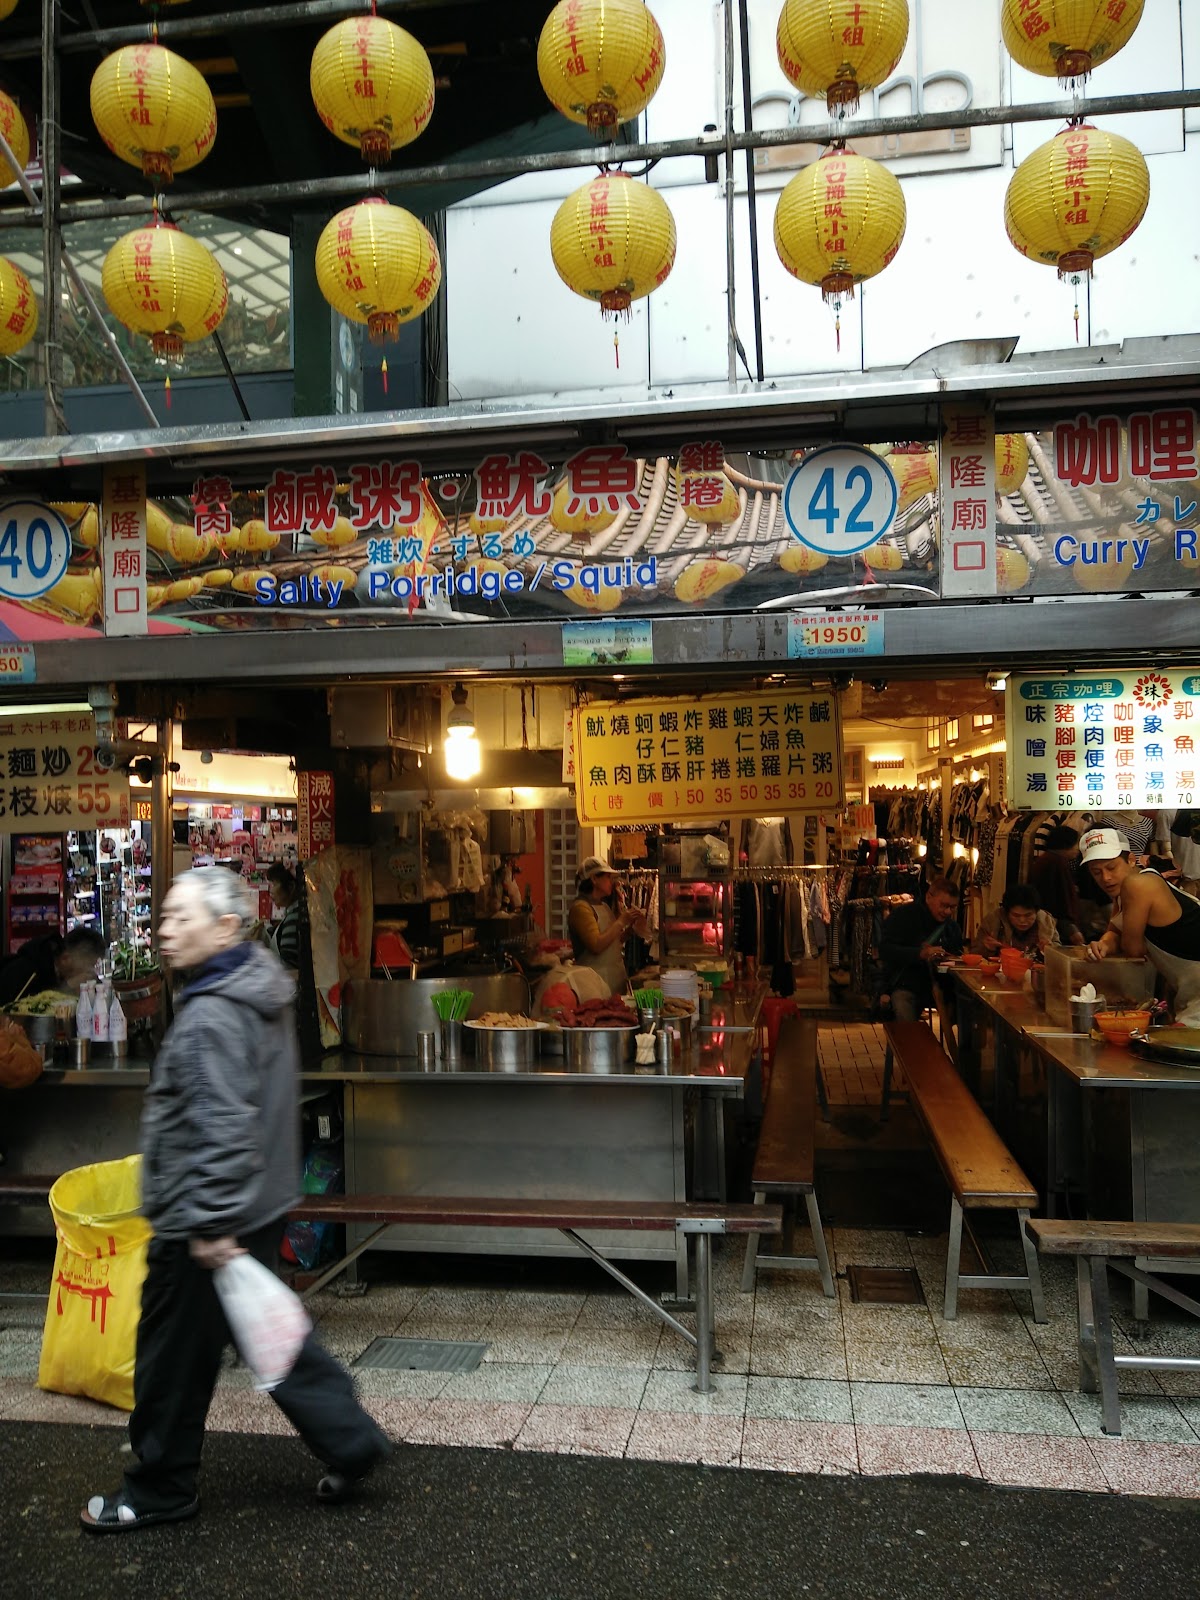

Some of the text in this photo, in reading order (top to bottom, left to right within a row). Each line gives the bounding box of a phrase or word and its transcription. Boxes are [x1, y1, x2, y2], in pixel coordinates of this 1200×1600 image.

[194, 476, 232, 536] 燒肉
[680, 441, 724, 506] 雞捲
[808, 465, 874, 533] 42
[950, 415, 987, 571] 基隆廟口
[0, 517, 52, 579] 40
[111, 474, 141, 614] 基隆廟口
[1054, 535, 1149, 569] Curry
[256, 574, 344, 608] Salty
[811, 627, 862, 644] 1950
[21, 718, 91, 735] 六十年老店
[635, 713, 657, 784] 蚵仔酥
[659, 711, 681, 783] 蝦仁酥
[683, 709, 706, 781] 炸豬肝
[733, 706, 756, 778] 蝦仁捲
[758, 705, 781, 777] 天婦羅
[783, 702, 806, 776] 炸魚片
[1025, 703, 1047, 792] 味噌湯
[1143, 714, 1165, 790] 象魚湯
[1173, 700, 1196, 789] 郭魚湯
[78, 783, 111, 814] 55
[311, 775, 332, 842] 滅火器
[686, 788, 704, 805] 50
[715, 787, 732, 803] 35
[740, 784, 758, 800] 50
[764, 784, 781, 801] 35
[788, 783, 806, 799] 35
[815, 781, 833, 798] 20
[855, 807, 874, 829] 100
[1058, 794, 1073, 806] 50
[1088, 794, 1102, 806] 50
[1118, 793, 1132, 806] 50
[1177, 792, 1193, 804] 70
